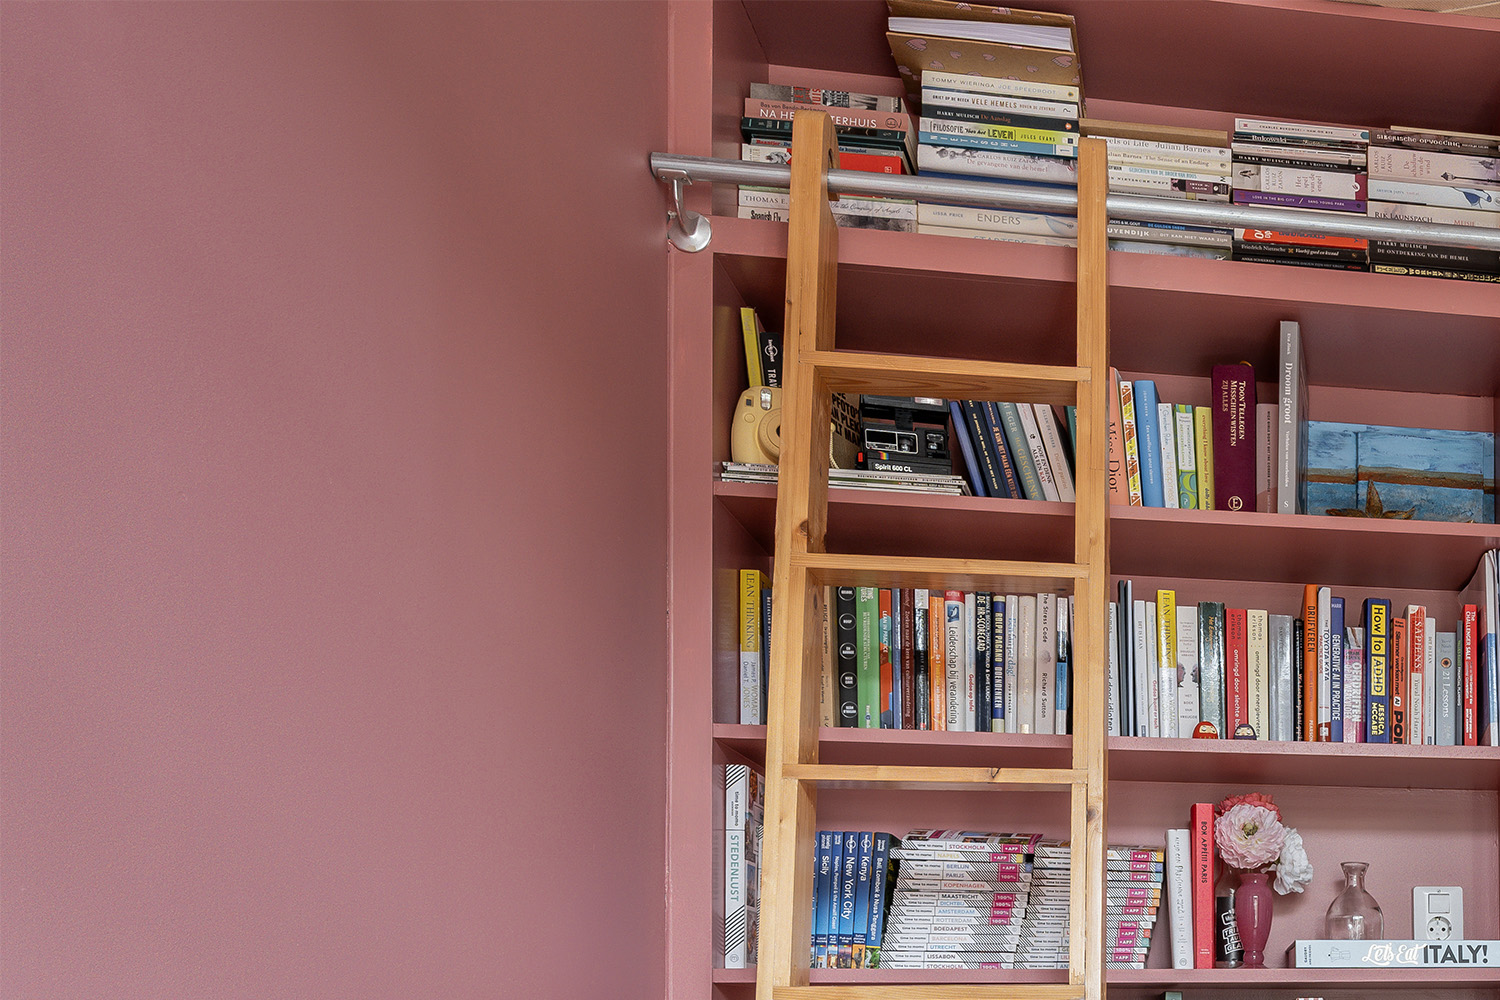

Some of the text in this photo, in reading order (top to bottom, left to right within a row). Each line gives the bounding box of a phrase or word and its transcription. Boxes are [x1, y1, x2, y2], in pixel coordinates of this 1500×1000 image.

[960, 80, 995, 89] WIERINGA
[971, 97, 1018, 109] VELE HEMELS
[759, 109, 878, 128] NA TERHUIS
[1155, 142, 1212, 154] Julian Barnes
[745, 195, 780, 204] THOMAS
[977, 213, 1022, 226] ENDERS
[1374, 211, 1390, 219] RIK
[1106, 228, 1150, 238] UYENDIJK
[767, 369, 778, 388] TRAV
[1282, 362, 1293, 424] Droom groot
[875, 463, 892, 472] Spirit
[1109, 459, 1121, 496] Dior
[746, 572, 755, 649] LEAN THINKING
[1307, 604, 1316, 653] DRIJFVEREN
[948, 626, 959, 668] Leiderschap
[1323, 628, 1331, 658] TOYOTA
[1332, 634, 1341, 671] GENERATIVE
[1413, 621, 1424, 673] SAPIENS
[1373, 658, 1384, 694] ADHD
[948, 681, 959, 724] verandering
[1332, 691, 1341, 721] PRACTICE
[1442, 671, 1450, 718] 21 Lessons
[730, 834, 740, 902] STEDENLUST
[820, 855, 830, 876] Sicily
[860, 856, 870, 881] Kenya
[841, 857, 855, 920] New York City
[938, 908, 976, 916] AMSTERDAM
[926, 952, 956, 960] LISSABON
[1361, 943, 1489, 966] Let's Eat ITALY!
